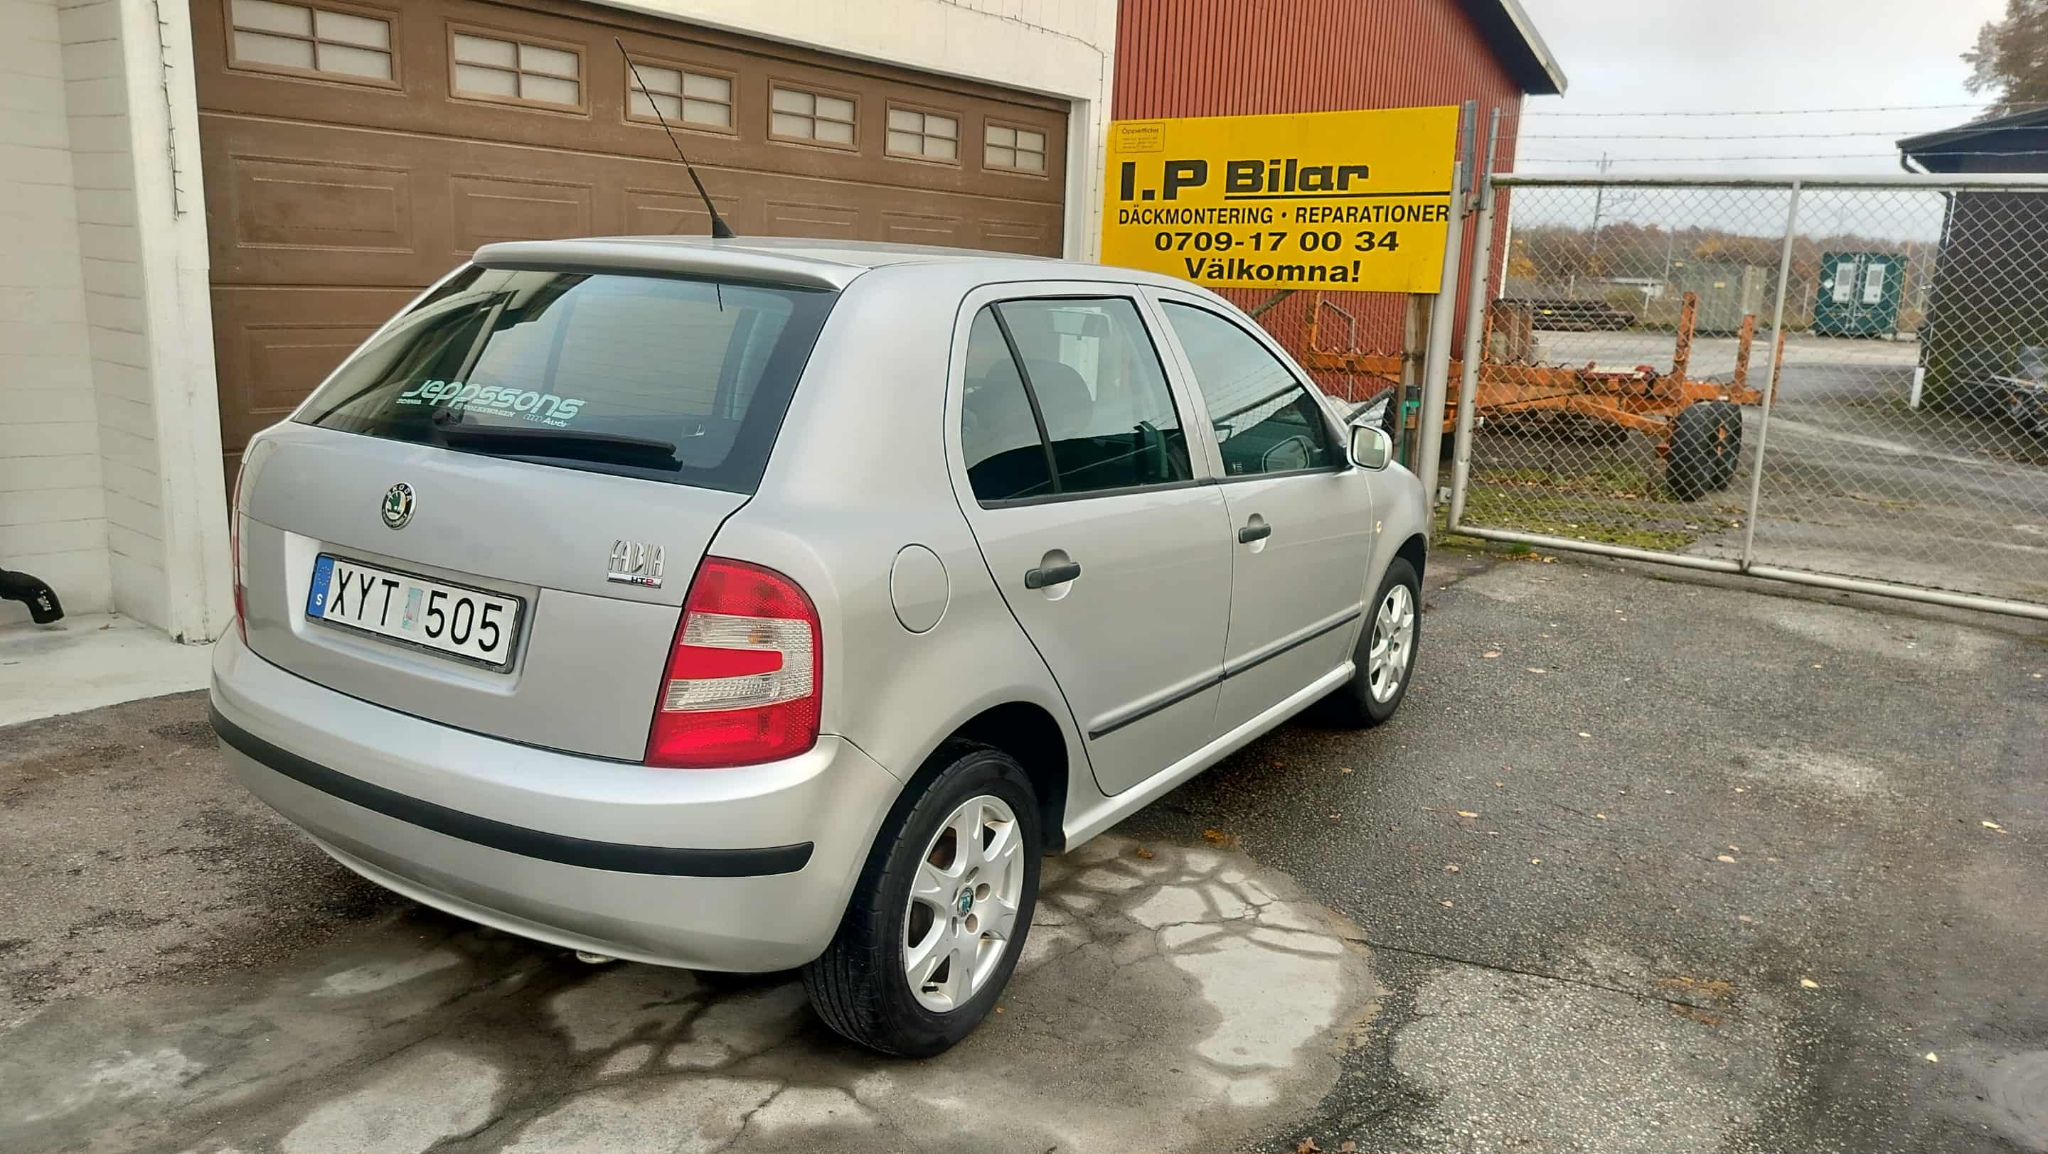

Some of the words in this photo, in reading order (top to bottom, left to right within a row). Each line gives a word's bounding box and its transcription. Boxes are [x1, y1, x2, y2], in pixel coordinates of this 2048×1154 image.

[1224, 158, 1369, 194] Bilar
[1118, 204, 1273, 225] DÄCKMONTERING
[1295, 204, 1449, 224] REPARATIONER
[1154, 231, 1287, 252] 0709-17
[1299, 231, 1342, 252] 00
[1354, 230, 1399, 252] 34
[1185, 257, 1361, 283] Välkomna!
[608, 539, 666, 578] FABIA
[315, 593, 324, 606] S
[330, 567, 400, 627] XYT
[425, 589, 503, 653] 505
